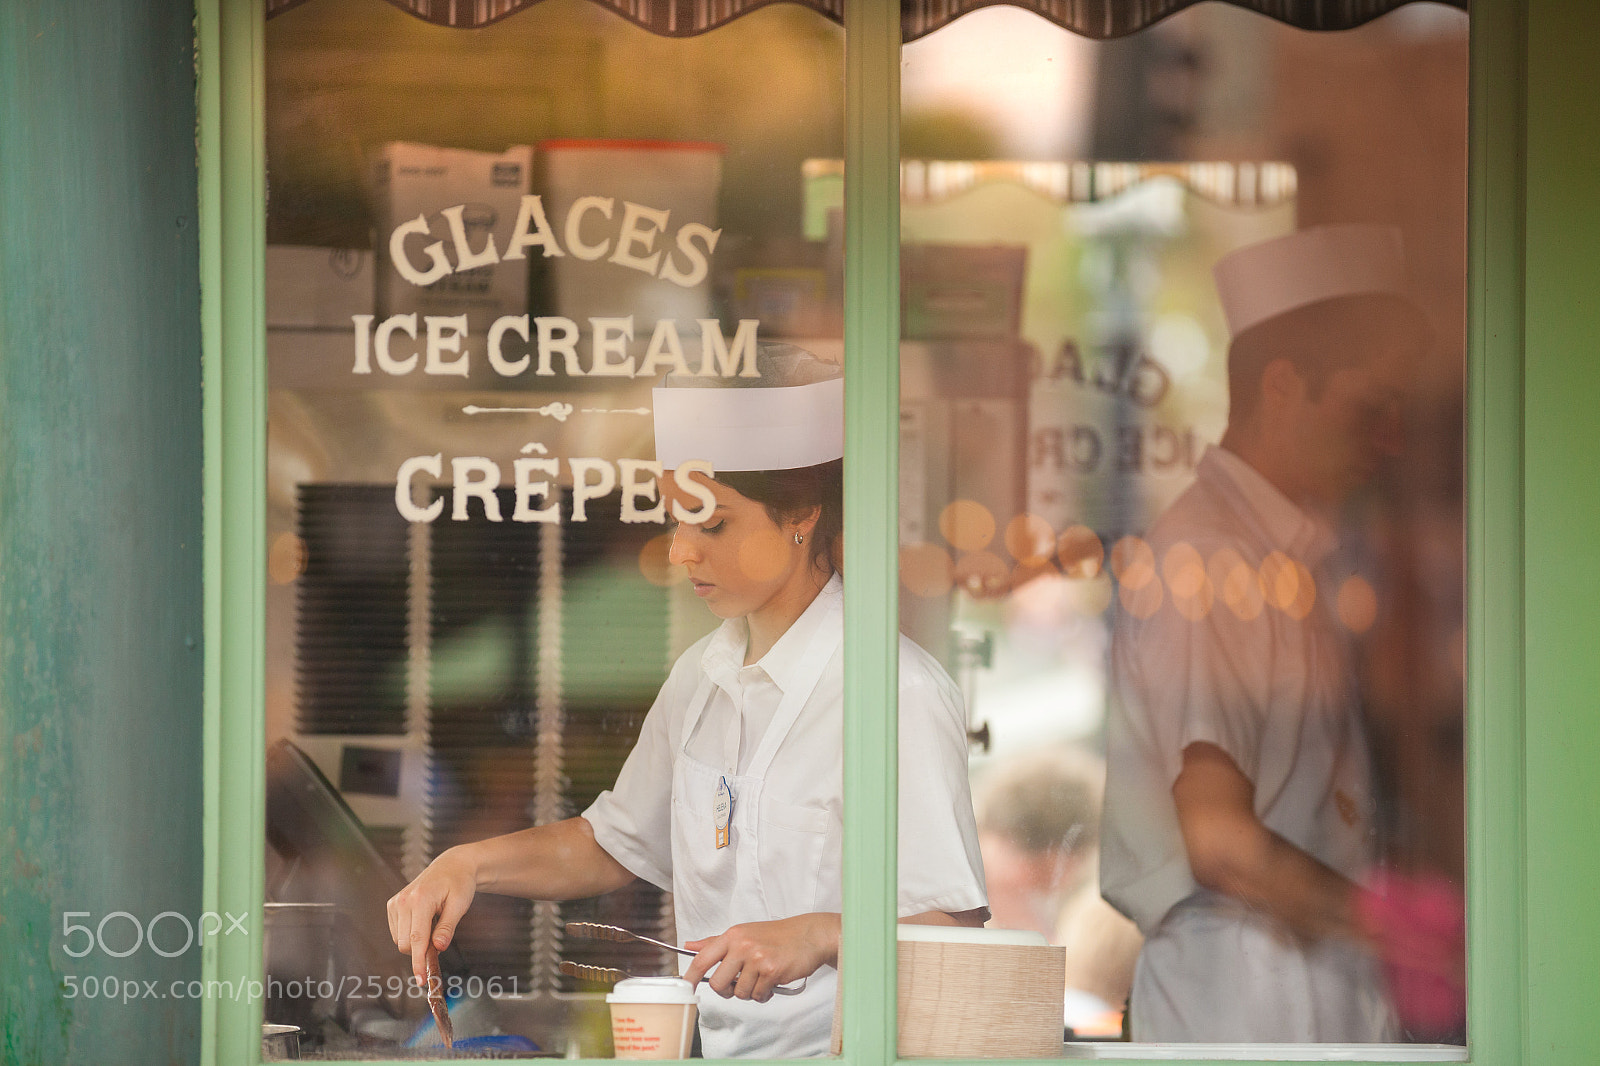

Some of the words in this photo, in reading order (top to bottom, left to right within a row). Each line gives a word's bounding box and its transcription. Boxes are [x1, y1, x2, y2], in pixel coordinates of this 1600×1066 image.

[390, 195, 722, 288] GLACES
[351, 313, 469, 379] ICE
[487, 314, 761, 379] CREAM
[395, 442, 717, 525] CRÊPES
